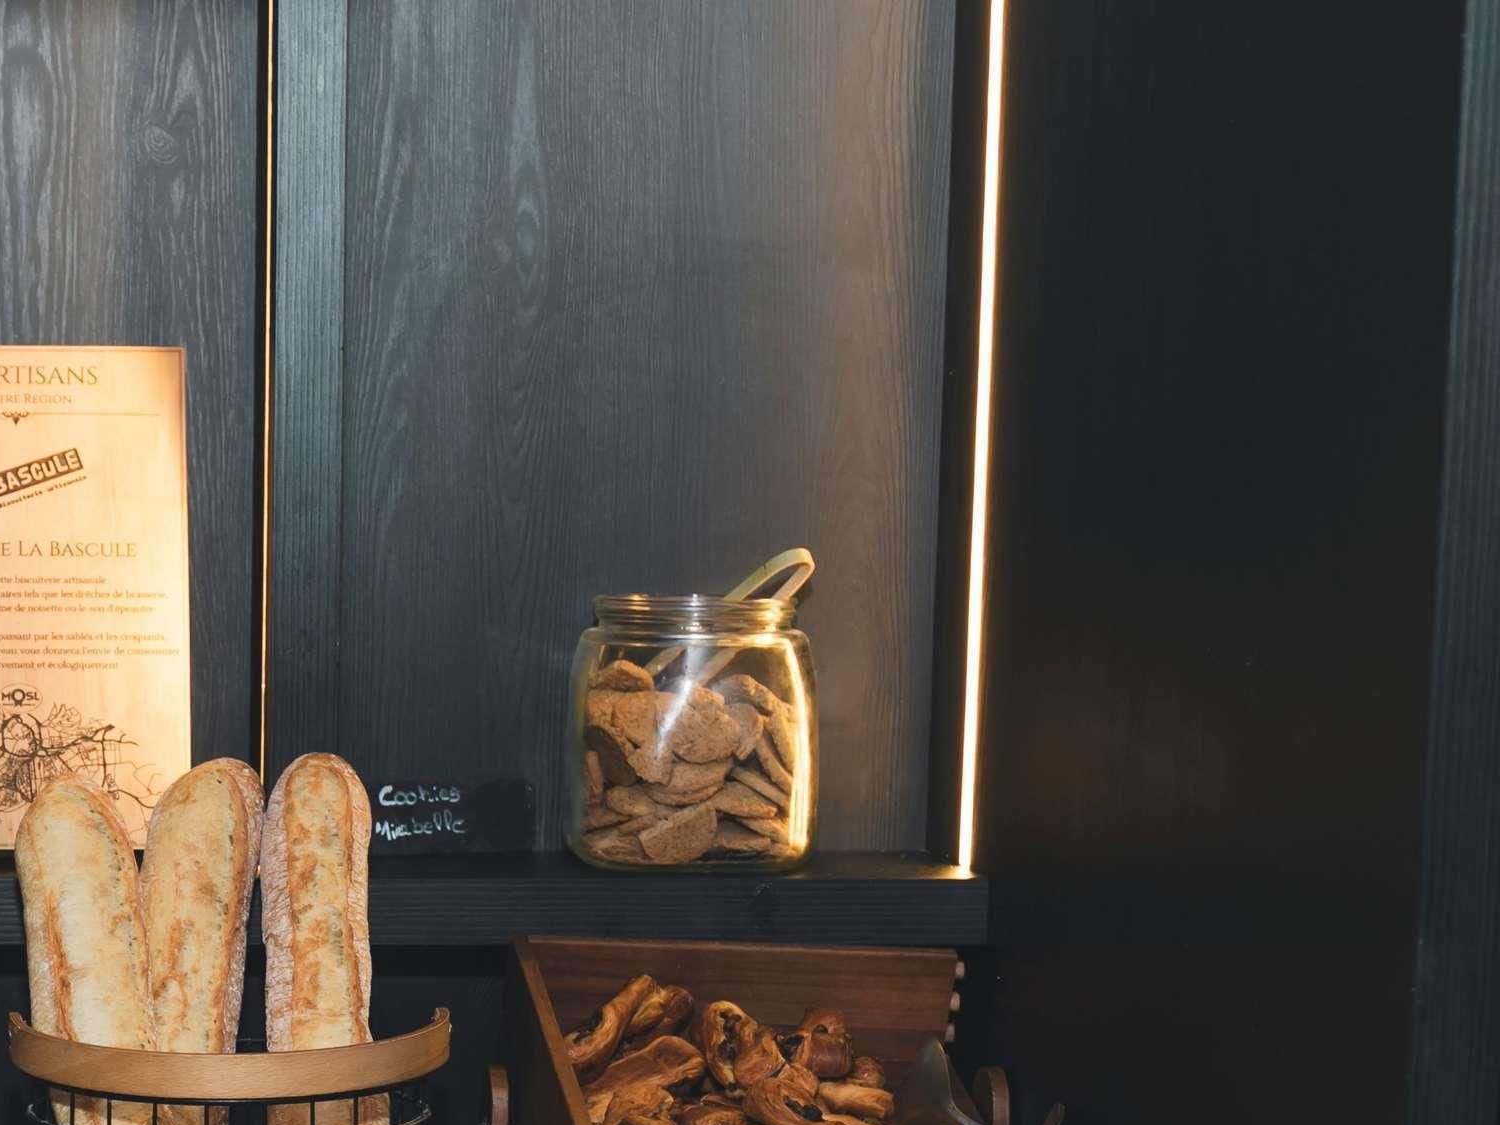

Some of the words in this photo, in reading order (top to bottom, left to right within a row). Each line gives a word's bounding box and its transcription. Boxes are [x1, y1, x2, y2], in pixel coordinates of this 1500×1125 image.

[18, 540, 42, 559] LA
[50, 540, 136, 559] BASCULE
[1, 688, 40, 704] MOSL
[378, 784, 460, 806] Cookies
[376, 809, 466, 841] Mirabelle
